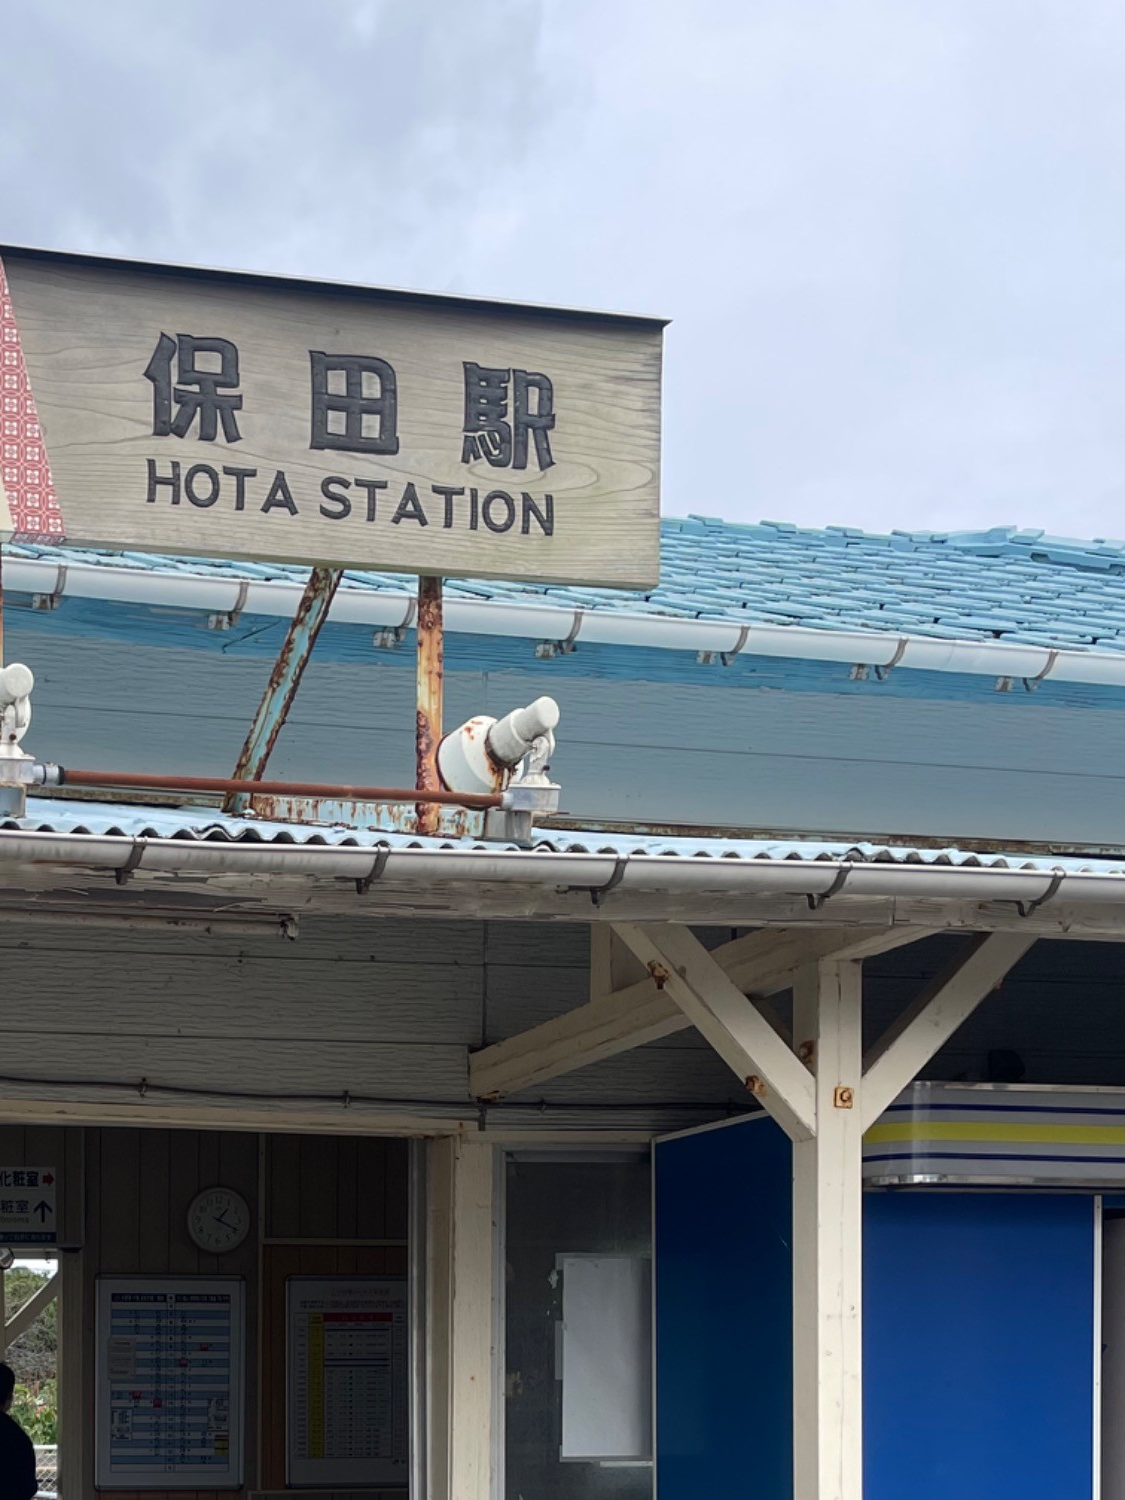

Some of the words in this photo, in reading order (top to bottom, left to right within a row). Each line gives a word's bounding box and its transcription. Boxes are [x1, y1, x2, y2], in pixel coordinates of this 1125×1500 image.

[142, 332, 557, 471] 保田駅
[146, 458, 299, 517] HOTA
[318, 474, 556, 537] STATION
[0, 1170, 39, 1187] 化粧室
